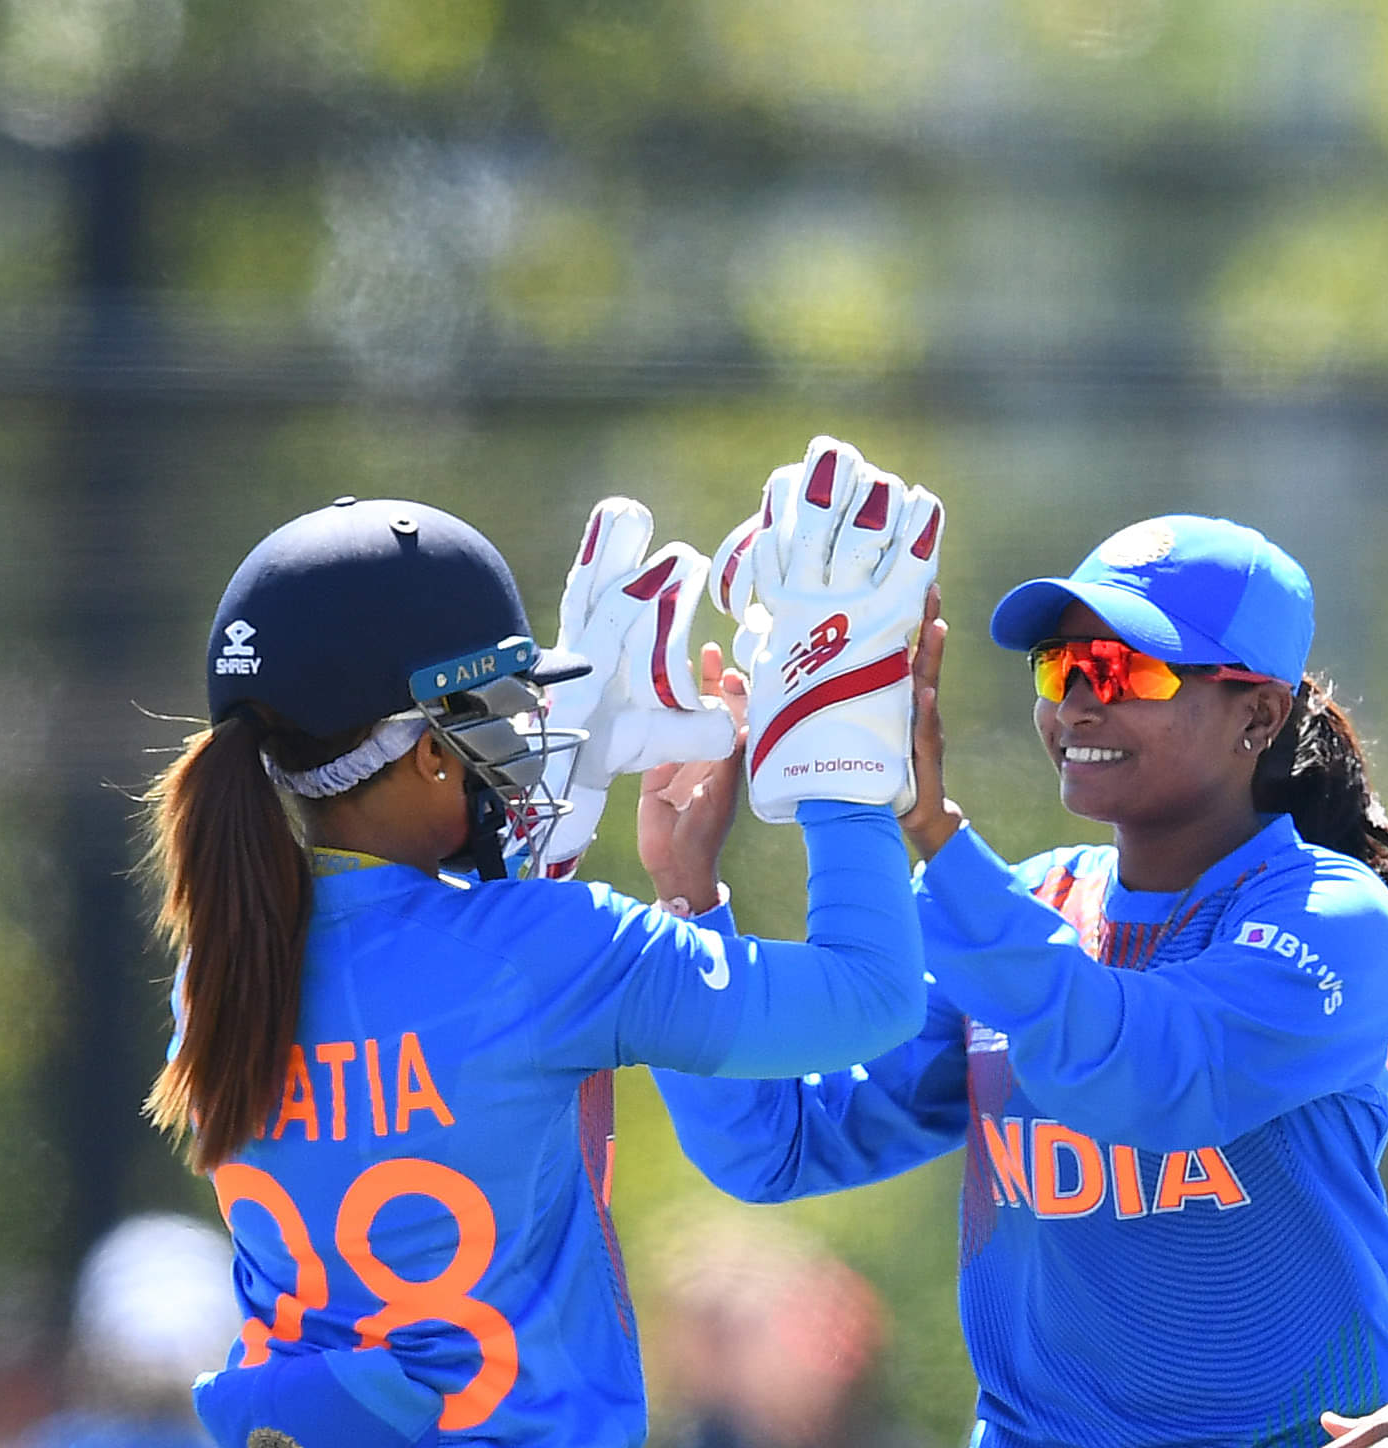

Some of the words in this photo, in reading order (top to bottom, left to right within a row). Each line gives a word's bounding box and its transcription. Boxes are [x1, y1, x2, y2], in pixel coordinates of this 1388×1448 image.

[216, 657, 261, 675] SHREY
[456, 655, 496, 684] AIR
[784, 763, 810, 777] new
[815, 758, 885, 773] balance
[253, 1032, 456, 1142] ATIA
[981, 1113, 1251, 1221] NDIA
